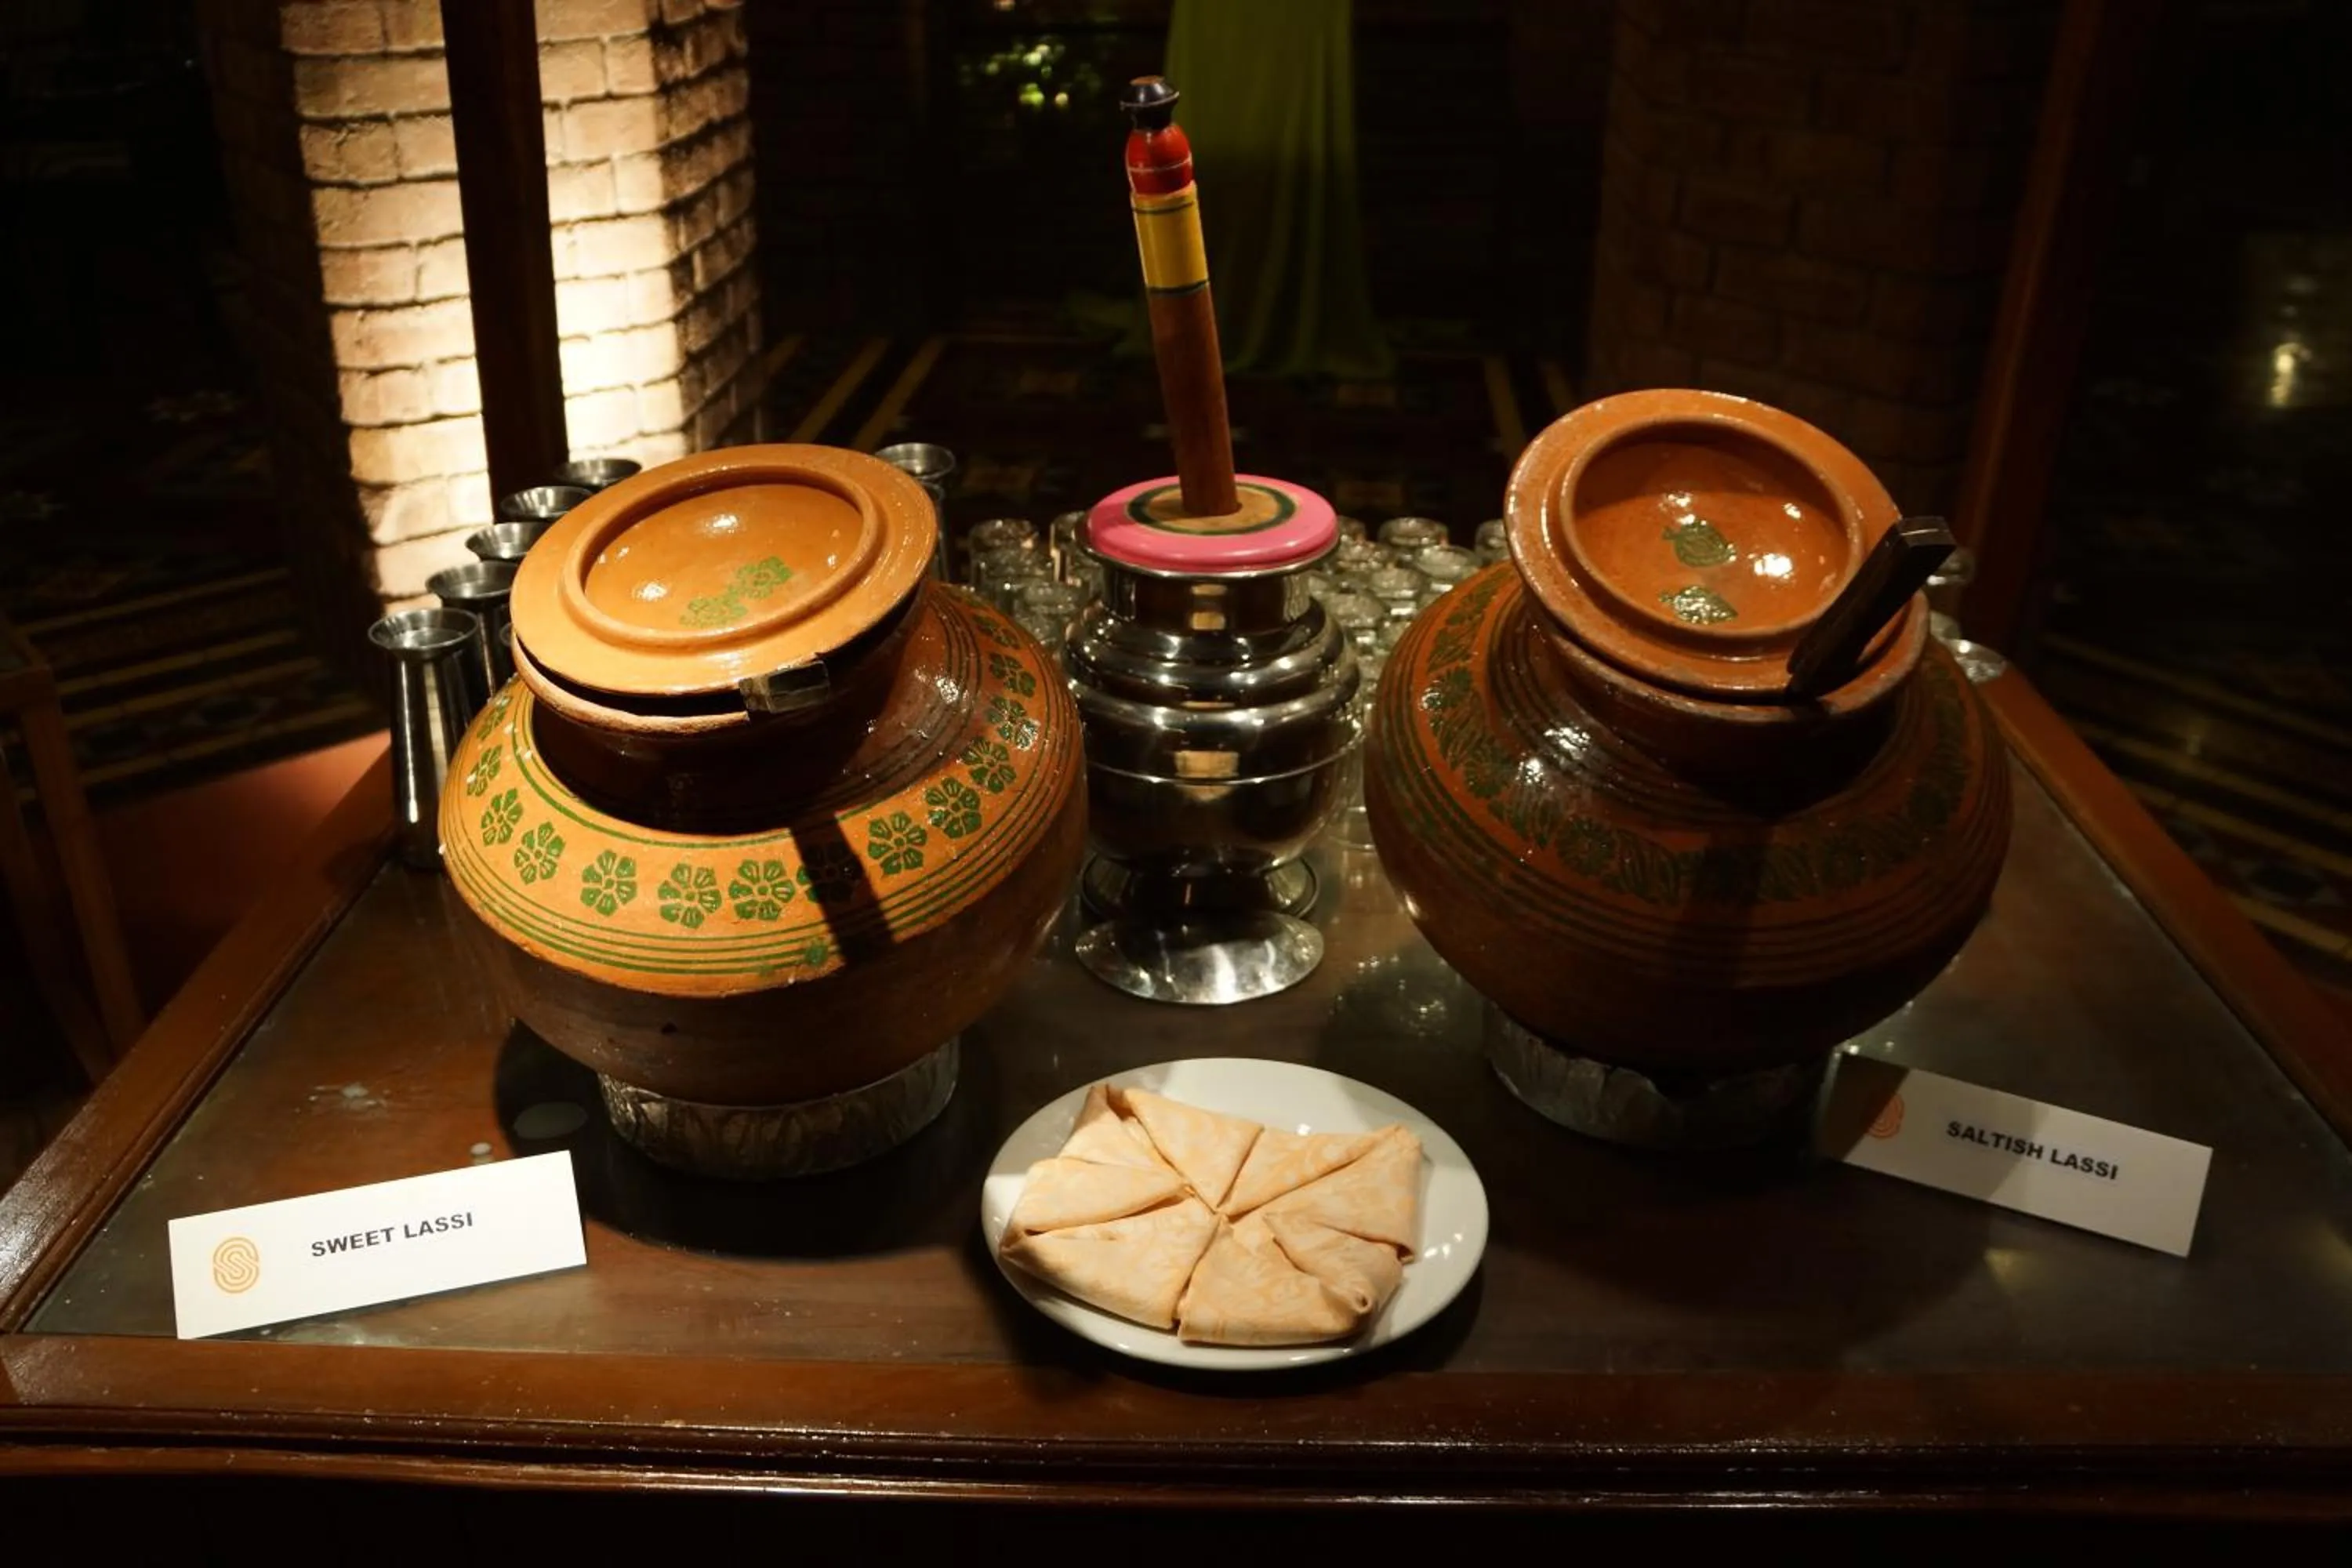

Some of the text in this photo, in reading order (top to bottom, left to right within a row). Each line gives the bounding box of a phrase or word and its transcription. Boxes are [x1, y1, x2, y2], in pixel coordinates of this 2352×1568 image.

[1947, 1120, 2118, 1181] SALTISH LASSI
[311, 1212, 473, 1258] SWEET LASSI
